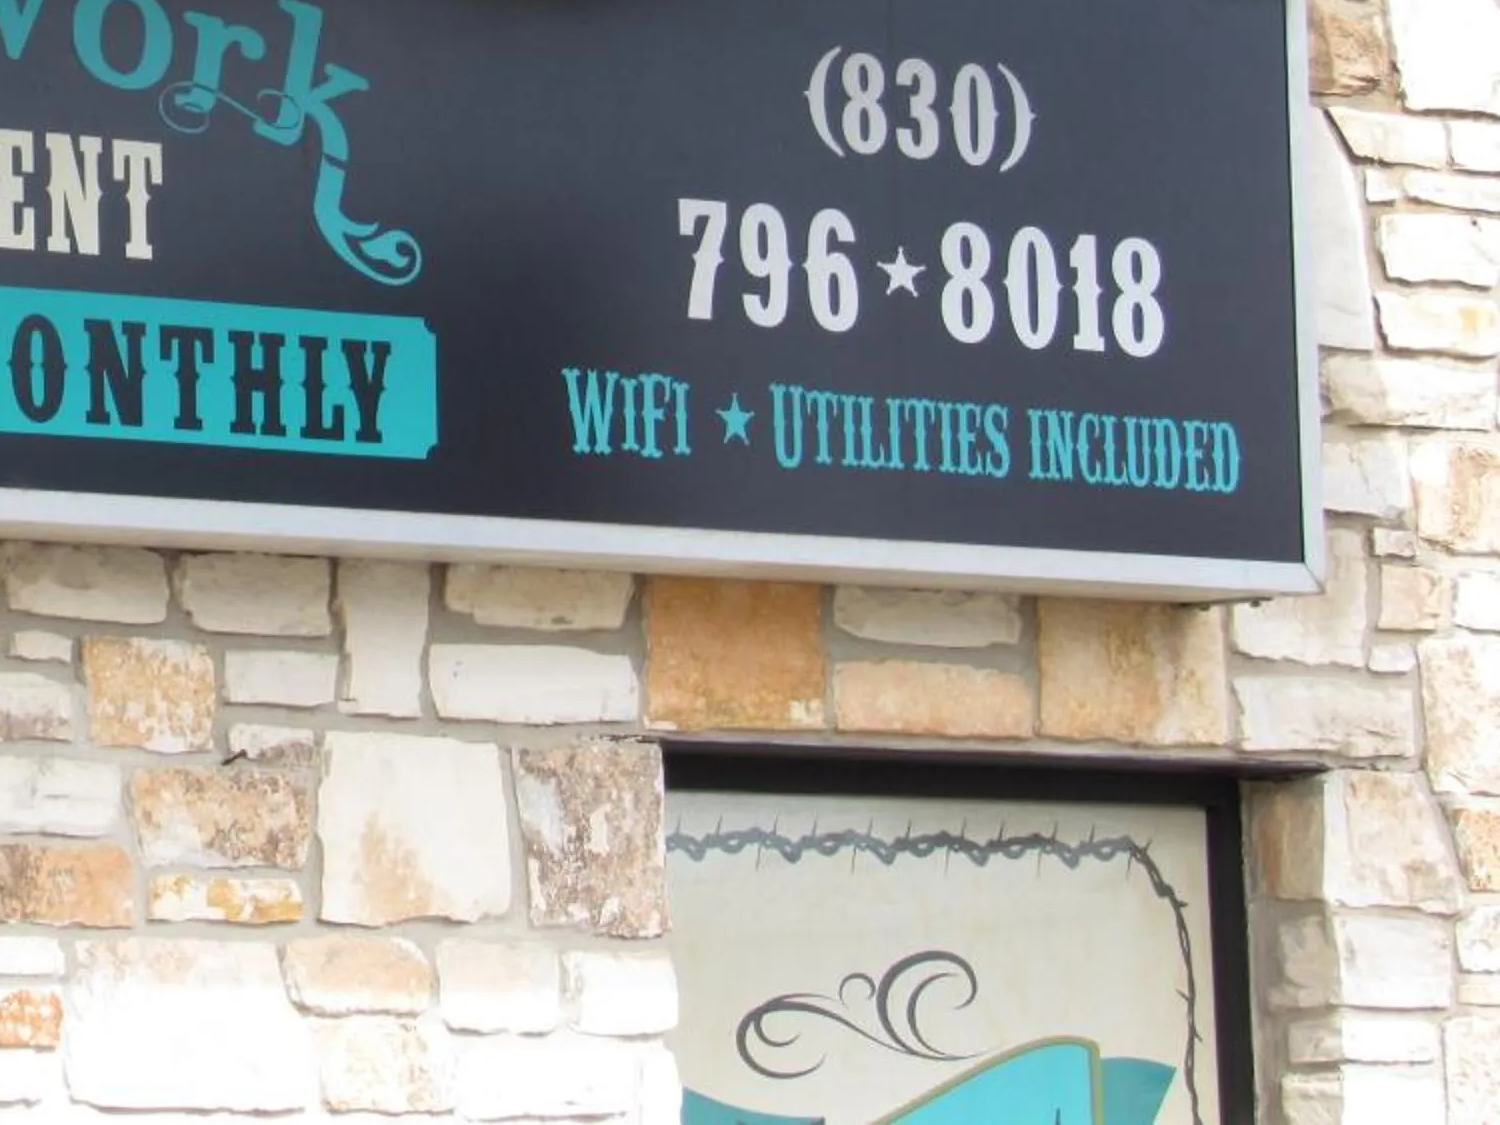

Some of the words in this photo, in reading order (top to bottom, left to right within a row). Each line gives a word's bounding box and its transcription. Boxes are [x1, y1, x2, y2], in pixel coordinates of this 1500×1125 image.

[804, 45, 1036, 173] (830)
[677, 198, 860, 334] 796
[940, 221, 1166, 359] 8018
[769, 383, 1011, 479] UTILITIES
[1028, 409, 1242, 495] INCLUDED
